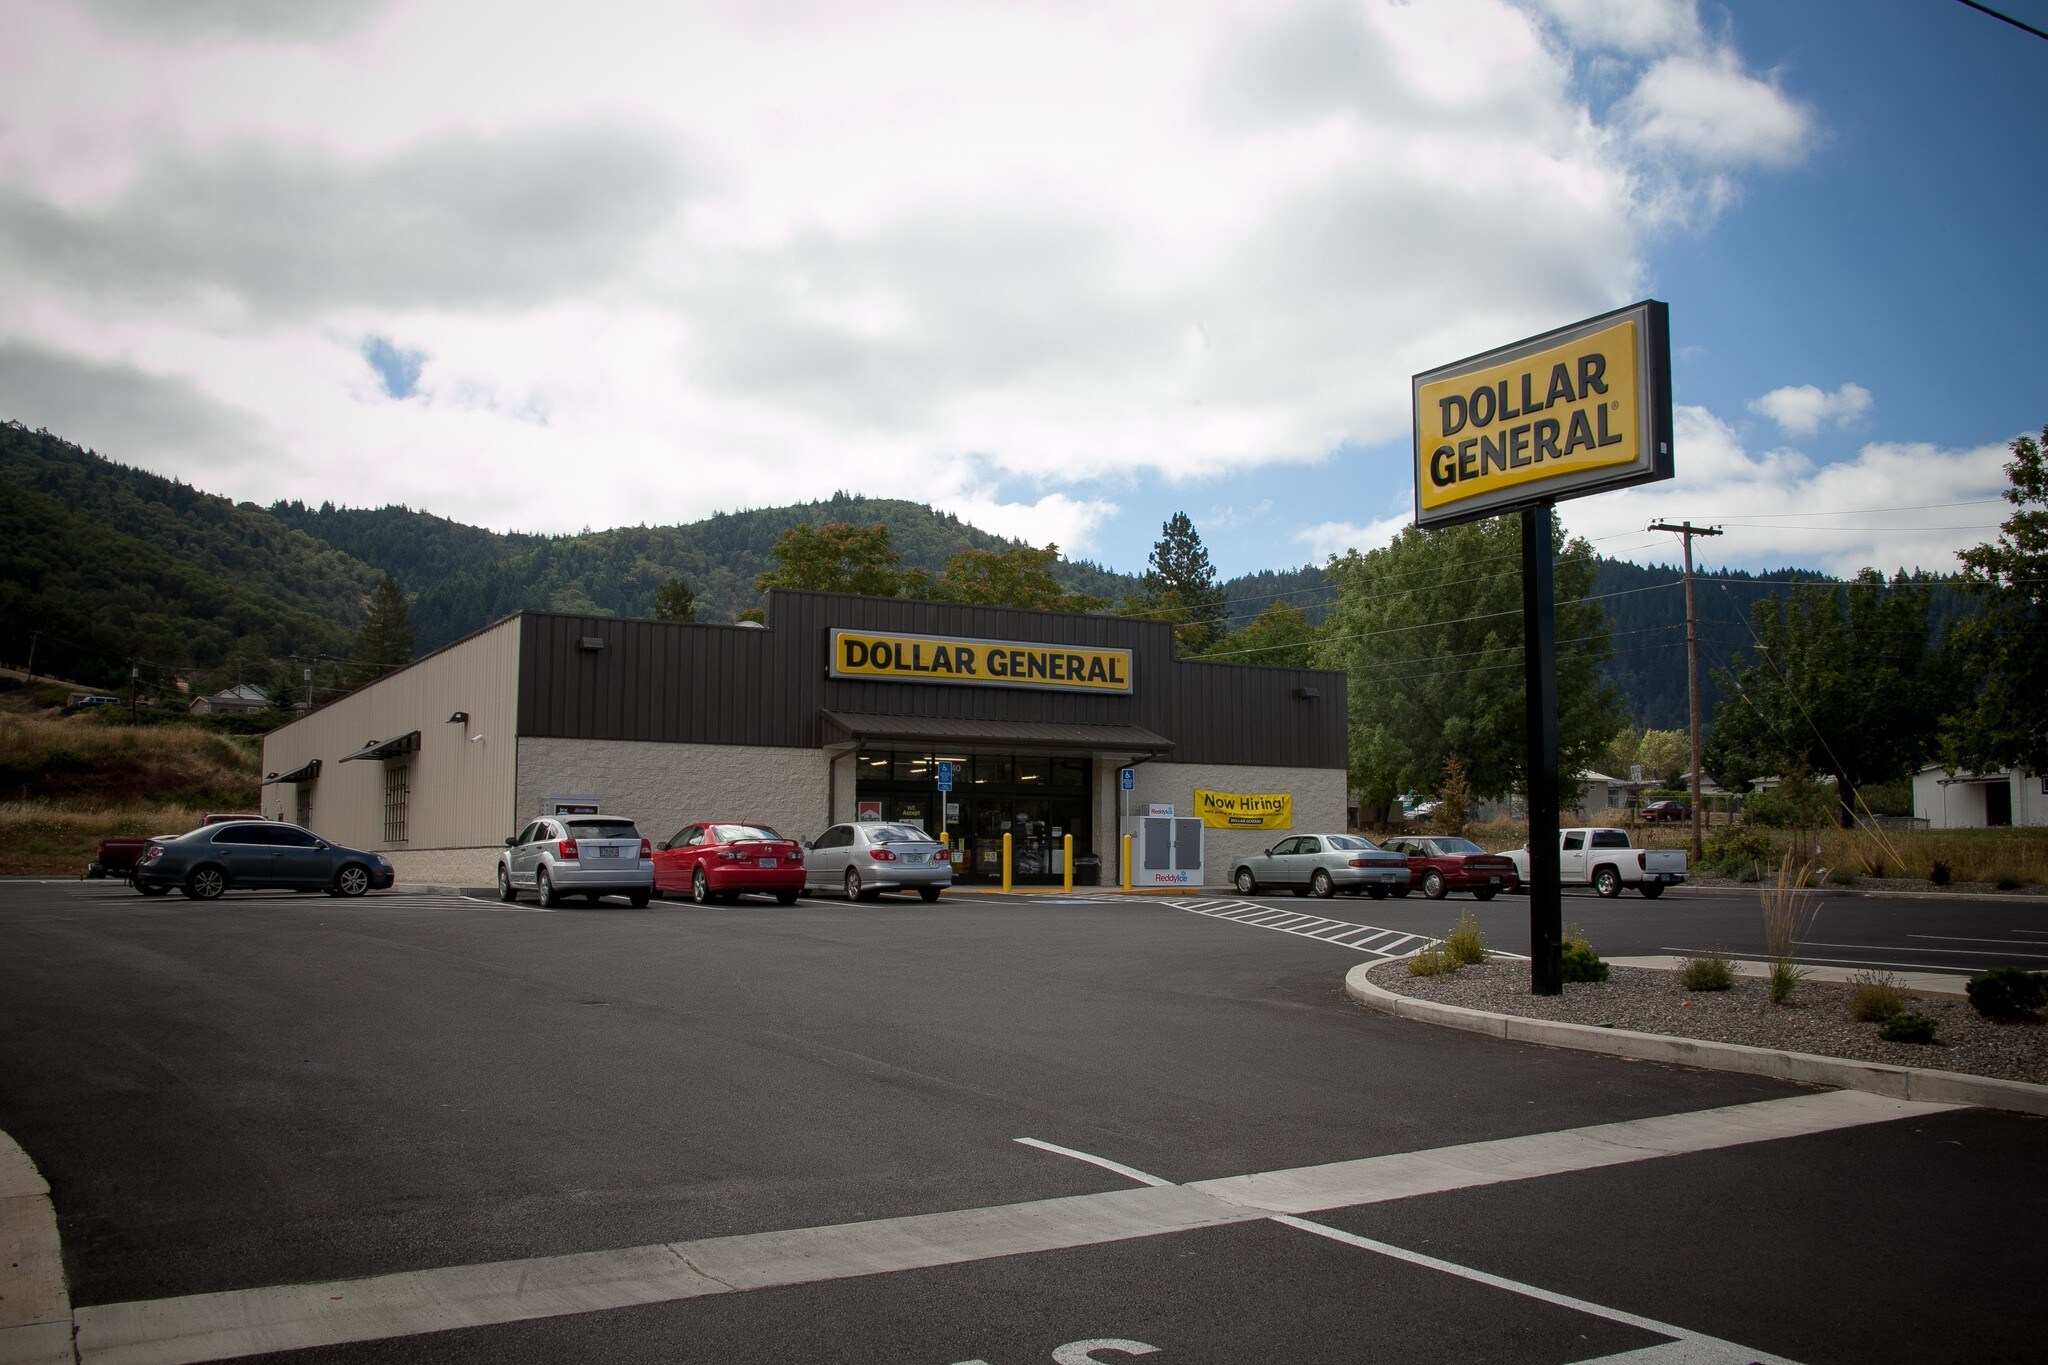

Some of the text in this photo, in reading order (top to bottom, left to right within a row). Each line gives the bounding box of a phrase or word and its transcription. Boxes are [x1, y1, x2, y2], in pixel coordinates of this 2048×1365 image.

[1439, 353, 1608, 437] DOLLAR
[1430, 403, 1622, 486] GENERAL
[843, 639, 1124, 684] DOLLAR GENERAL
[1204, 793, 1285, 812] Now Hiring!
[1155, 873, 1188, 884] ReddyIce
